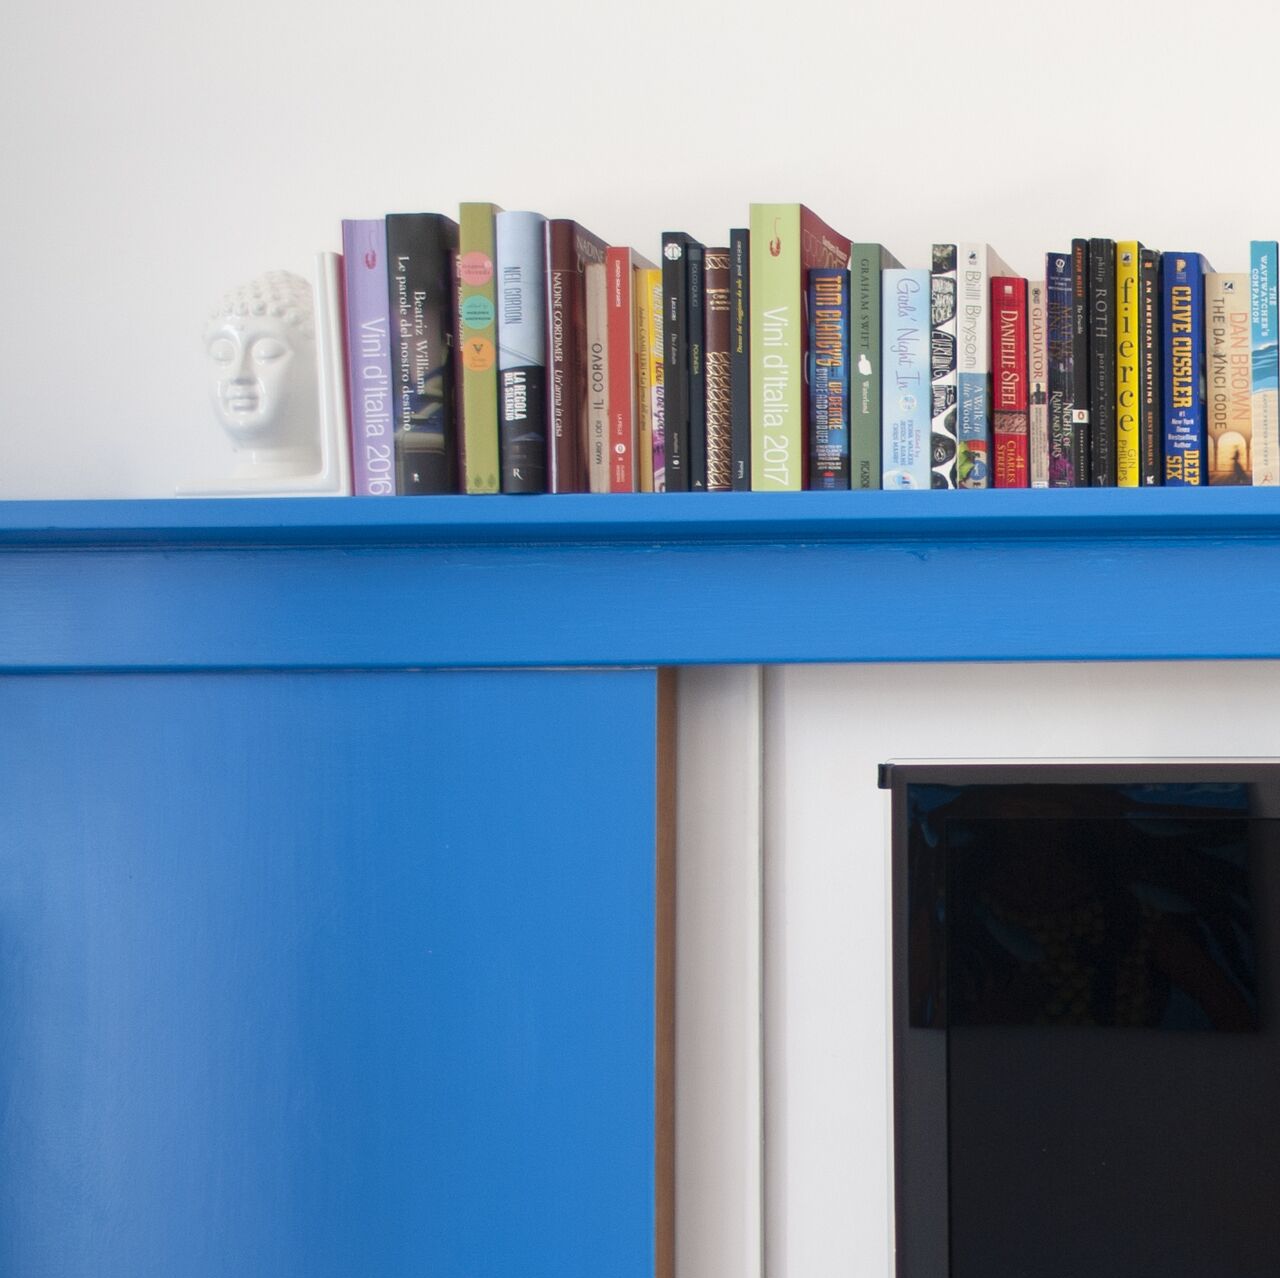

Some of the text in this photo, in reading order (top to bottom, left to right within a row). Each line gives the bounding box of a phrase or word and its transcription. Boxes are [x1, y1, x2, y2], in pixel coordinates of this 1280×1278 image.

[504, 267, 522, 324] NEIL GORDON
[815, 275, 842, 305] TOM
[1252, 268, 1260, 324] COMPANION
[1260, 255, 1270, 336] WAVEWATCHER'S
[1269, 286, 1277, 305] THE
[396, 256, 415, 431] Le parole del nostro destino
[414, 291, 429, 395] Beatriz Williams
[815, 309, 843, 367] CLANCY'S
[860, 259, 870, 414] GRAHAM SWIFT Waterland
[890, 328, 919, 365] Night
[963, 271, 981, 369] Bill Bryson
[1032, 308, 1043, 379] GLADIATOR
[1171, 286, 1192, 408] CLIVE CUSSLER
[553, 272, 563, 437] NADINE GORDIMER Un'arma in casa
[896, 371, 920, 389] In
[1001, 310, 1018, 407] DANIELLE STEEL
[1095, 256, 1108, 460] philip ROTH portnoy's COMPLAINT
[1213, 297, 1229, 429] THE DA VINCI CODE
[1229, 312, 1250, 421] DAN BROWN
[361, 317, 392, 495] Vini d'Italia 2016
[505, 372, 514, 420] DEL SILENZIO
[514, 372, 526, 419] LA REGOLA
[763, 307, 789, 485] Vini d'Italia 2017
[815, 368, 827, 444] DIVIDE AND CONQUER
[962, 383, 973, 434] the Woods
[973, 395, 983, 420] Walk
[974, 422, 983, 433] in
[997, 444, 1006, 478] STREET
[1006, 440, 1016, 483] CHARLES
[1016, 455, 1024, 468] 44
[1118, 439, 1127, 481] PHILLIPS
[1127, 448, 1136, 469] GIN
[1166, 455, 1183, 480] SIX
[1183, 449, 1200, 485] DEEP
